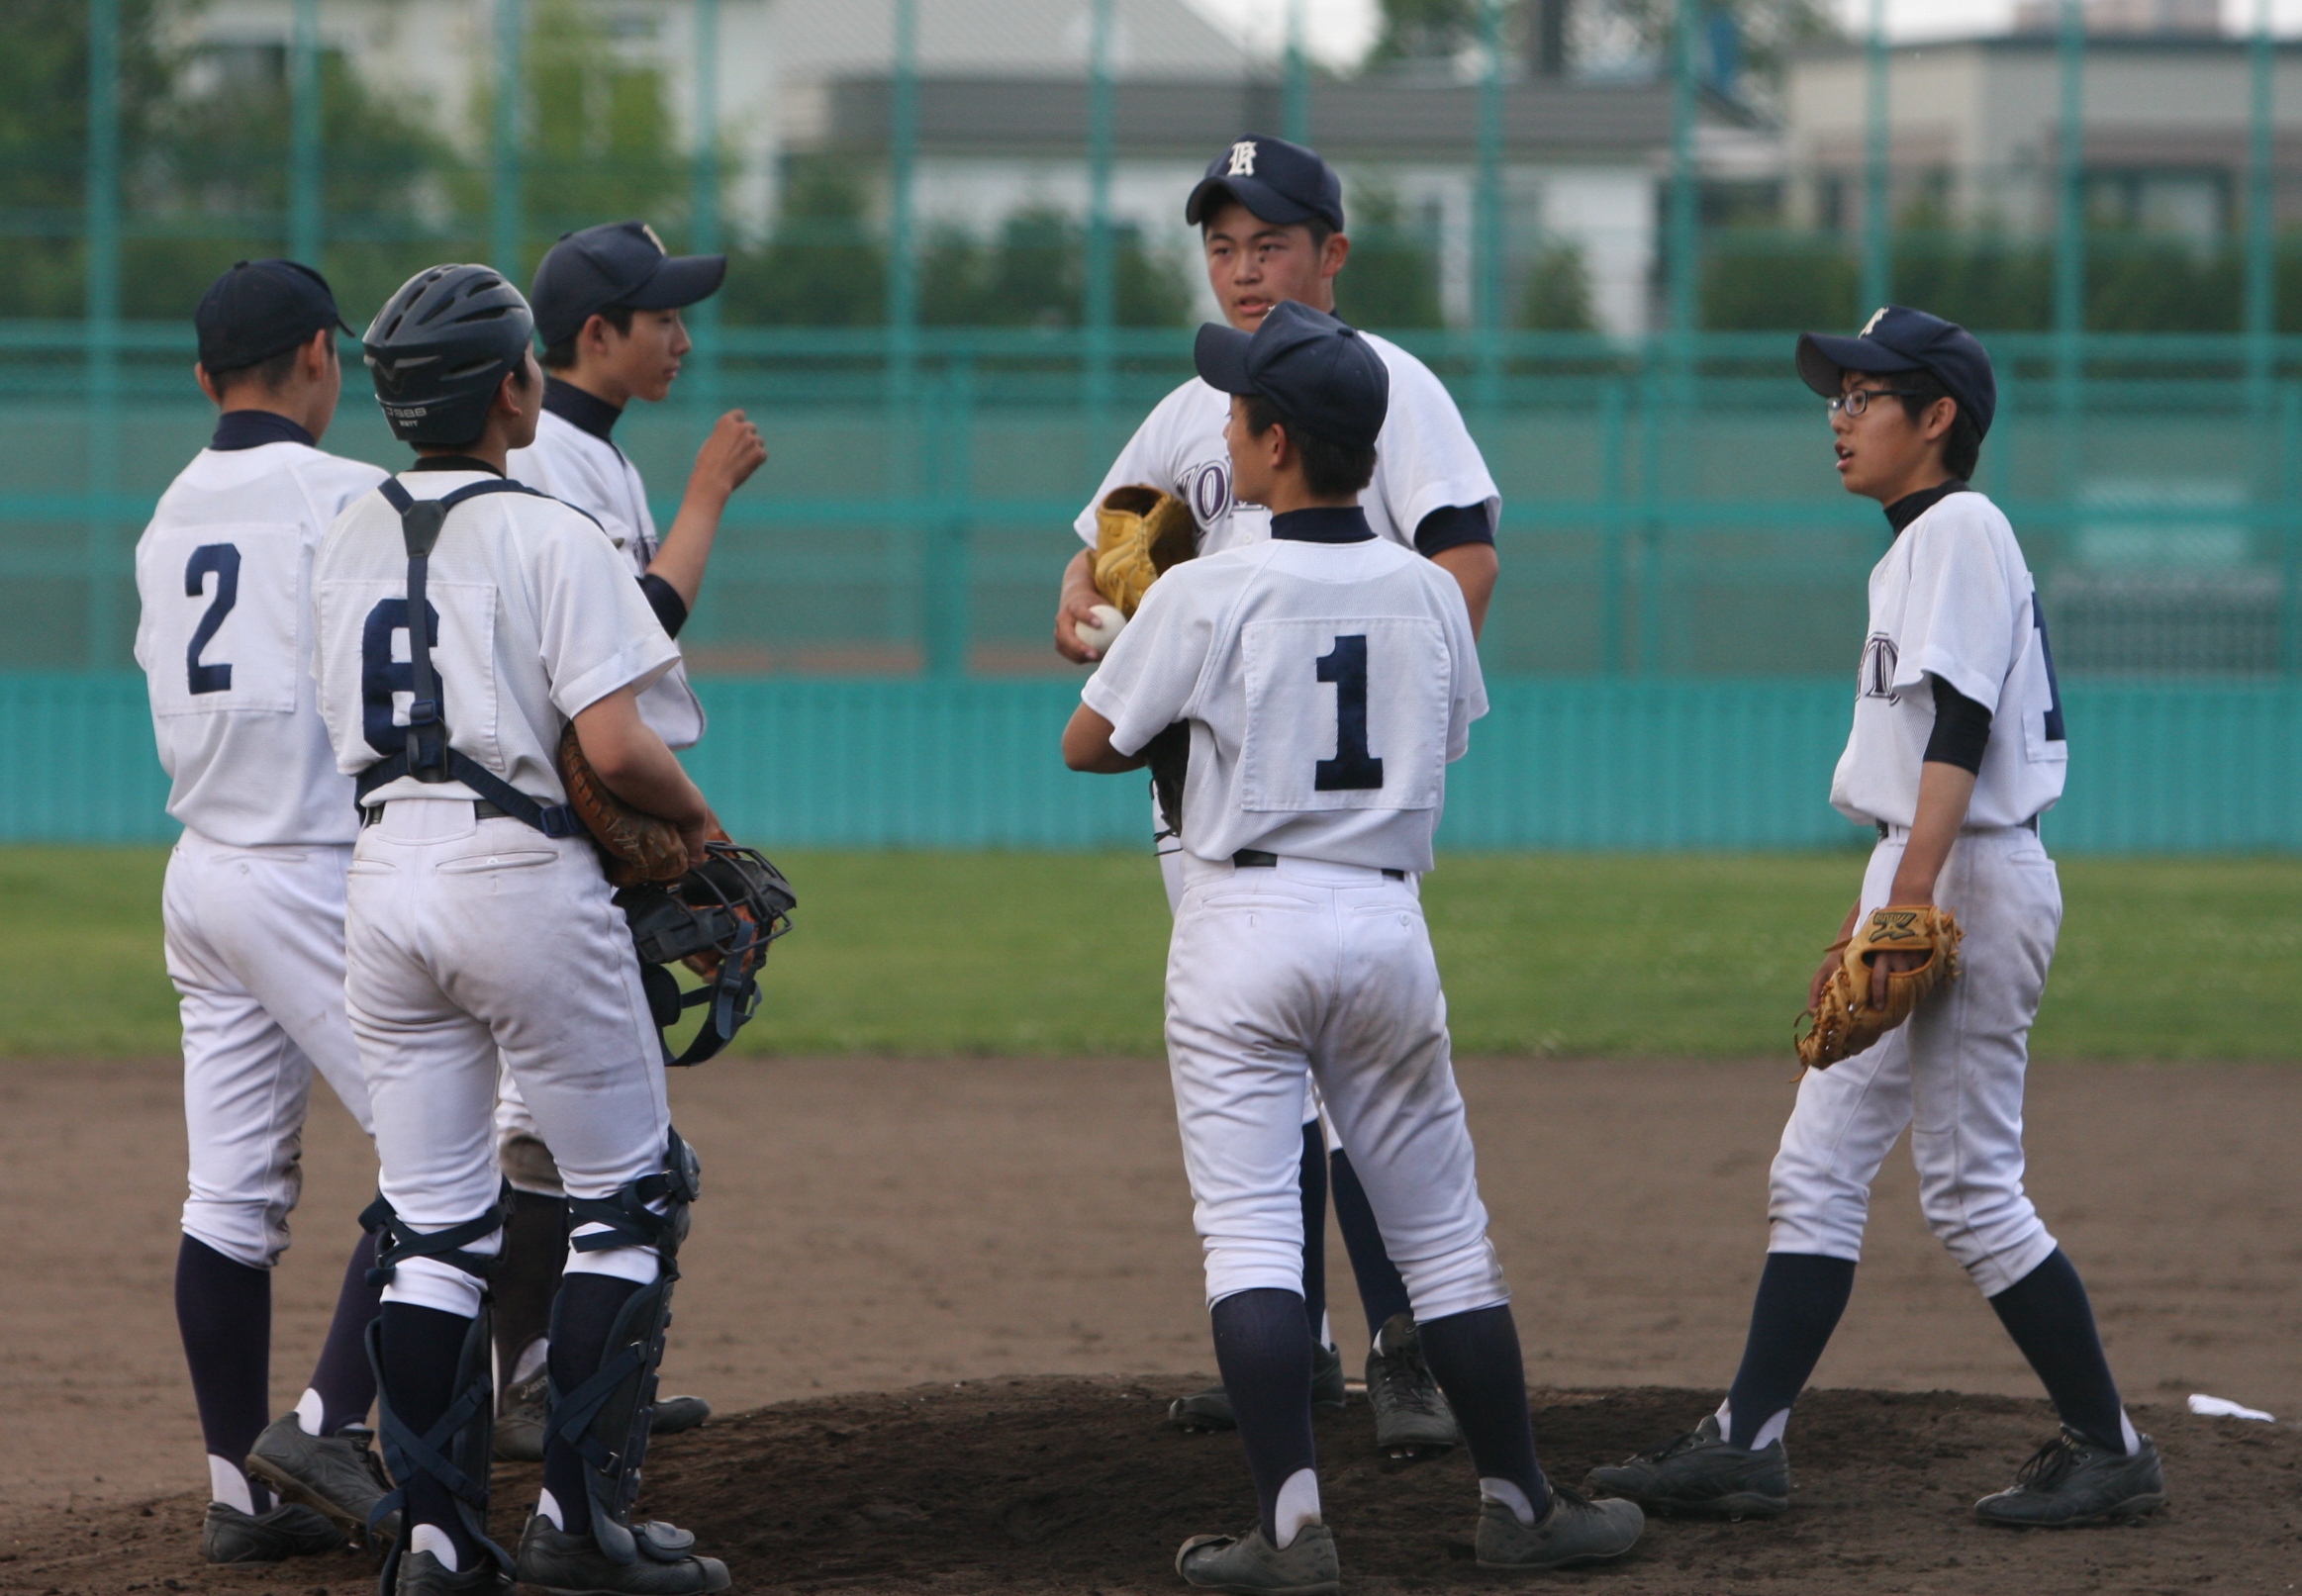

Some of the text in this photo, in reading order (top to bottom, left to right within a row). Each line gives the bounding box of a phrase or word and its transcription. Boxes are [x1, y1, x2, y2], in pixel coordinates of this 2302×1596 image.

[185, 543, 241, 696] 2
[361, 598, 445, 756] 6
[1313, 634, 1384, 792] 1
